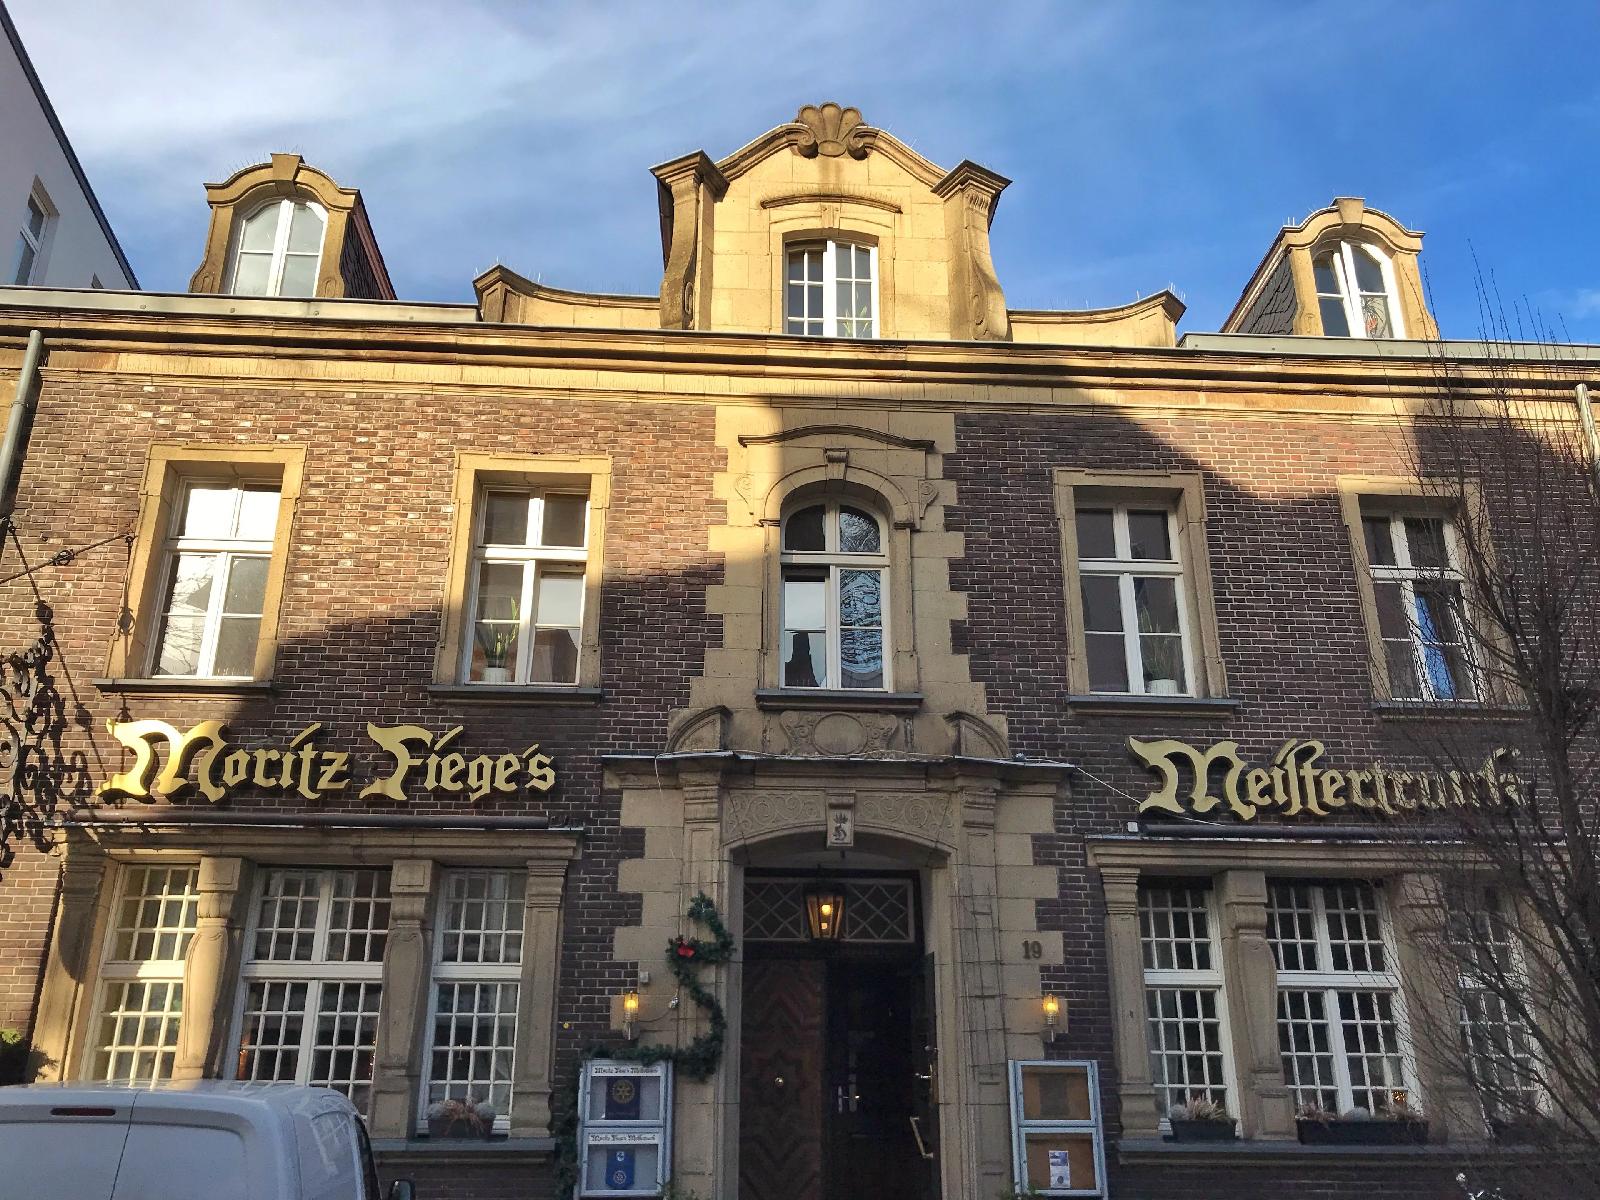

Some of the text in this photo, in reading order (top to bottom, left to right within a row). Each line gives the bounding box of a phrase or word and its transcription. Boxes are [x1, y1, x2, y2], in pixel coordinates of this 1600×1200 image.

[95, 718, 556, 803] Moritz Fiege's
[1022, 940, 1042, 960] 19
